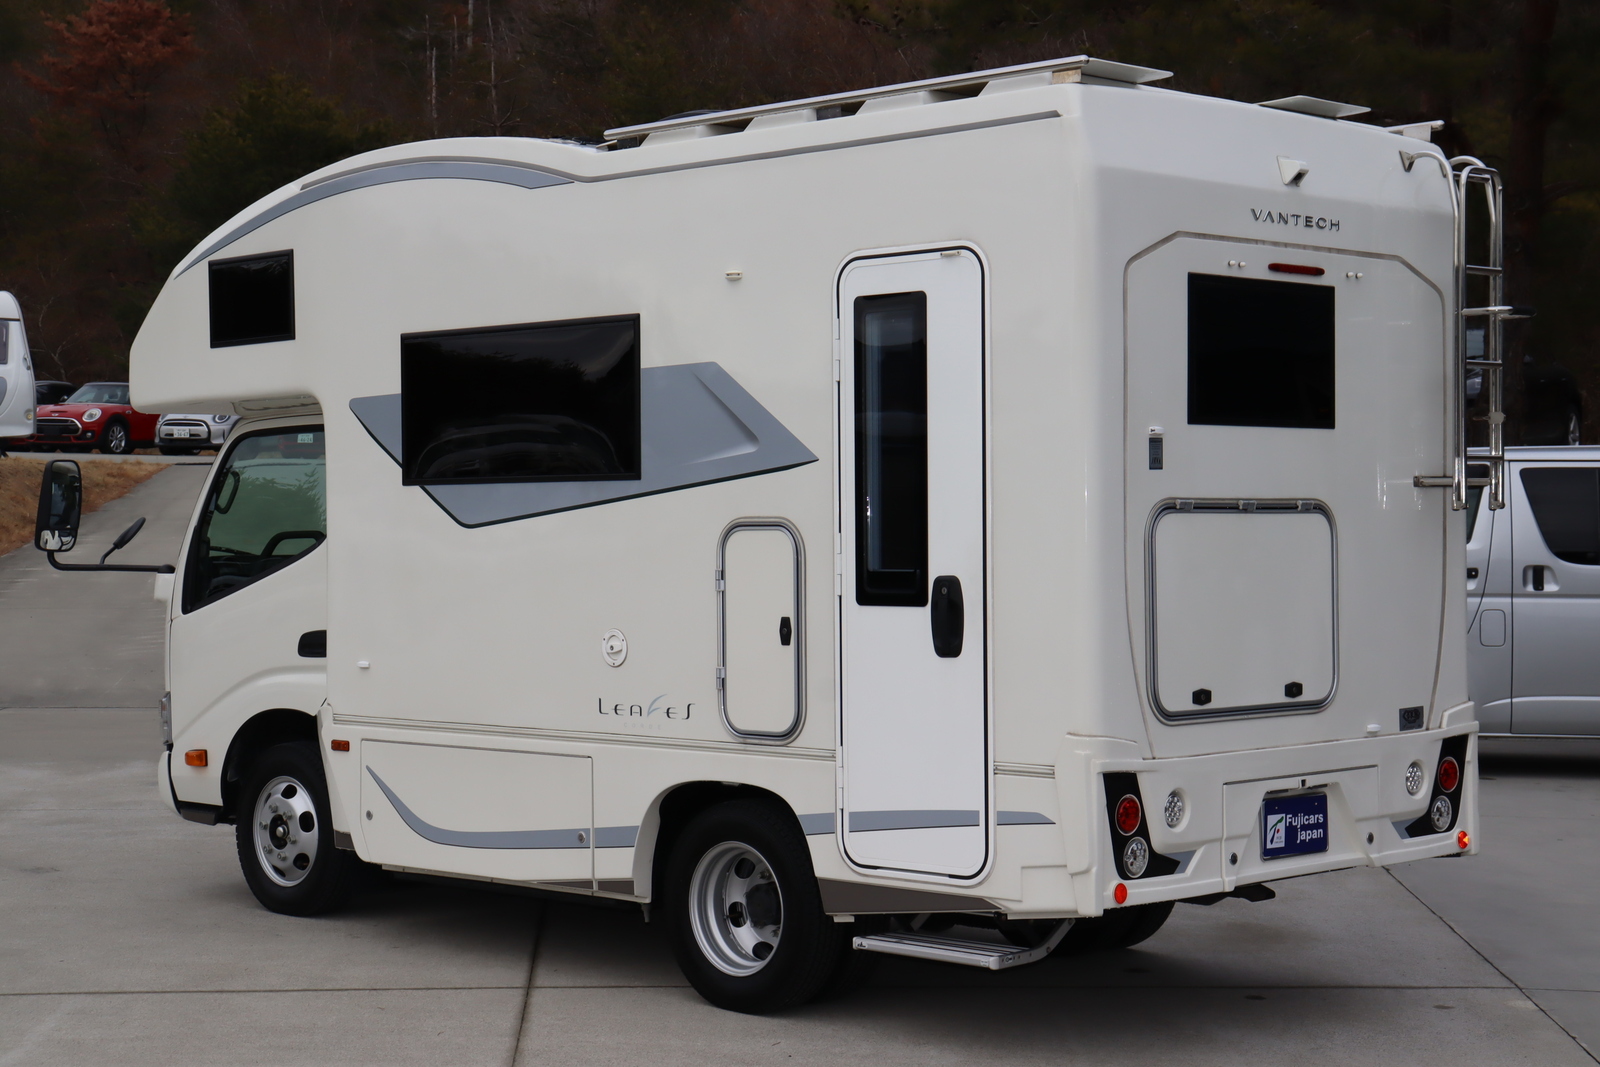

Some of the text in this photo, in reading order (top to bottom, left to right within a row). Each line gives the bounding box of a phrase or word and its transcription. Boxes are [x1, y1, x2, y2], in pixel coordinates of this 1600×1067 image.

[1250, 208, 1340, 232] VANTECH
[1286, 813, 1324, 828] Fujicars
[1297, 829, 1323, 843] japan
